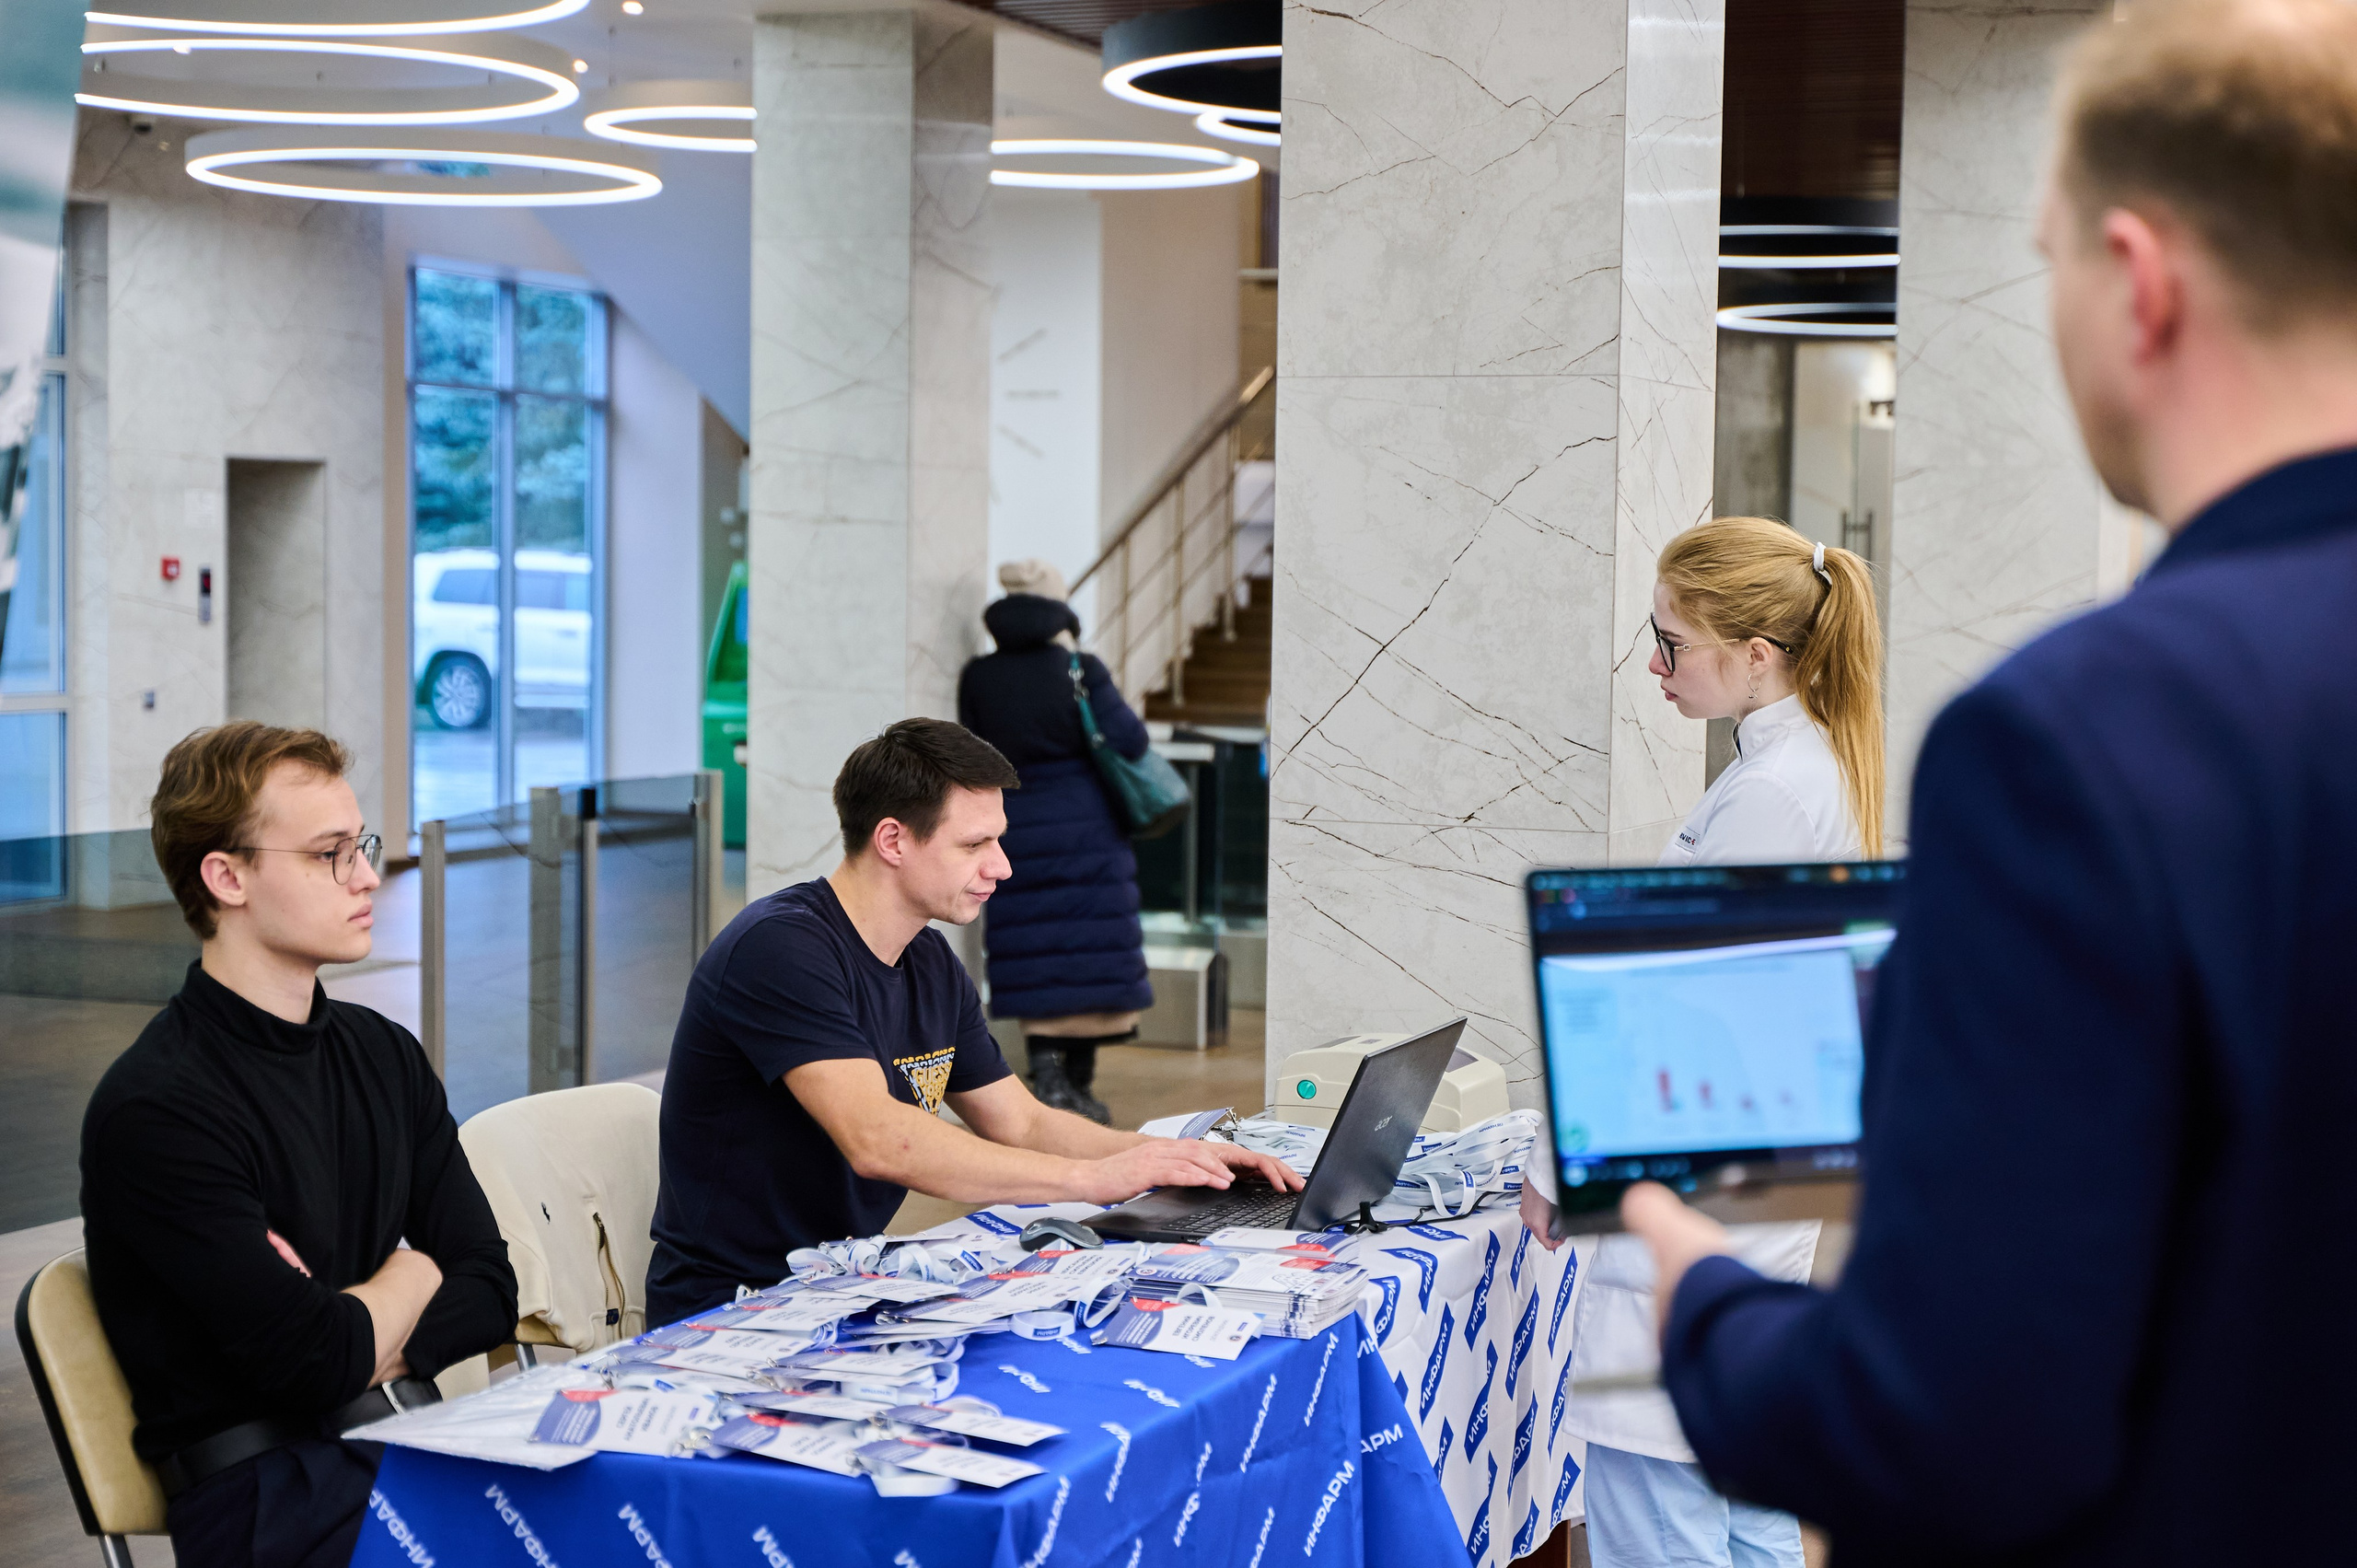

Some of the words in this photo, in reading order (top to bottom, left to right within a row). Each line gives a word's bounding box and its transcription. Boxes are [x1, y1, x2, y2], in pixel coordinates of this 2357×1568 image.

[1374, 1115, 1393, 1132] acer
[1376, 1279, 1397, 1334] ФАРМ
[1304, 1331, 1340, 1427] ИНФАРМ
[1421, 1321, 1448, 1410] ИНФАРМ
[1240, 1373, 1278, 1473] ИНФАРМ
[1360, 1423, 1404, 1454] АРМ
[369, 1488, 435, 1568] ИНФАР
[1304, 1459, 1355, 1558] ИНФАРМ
